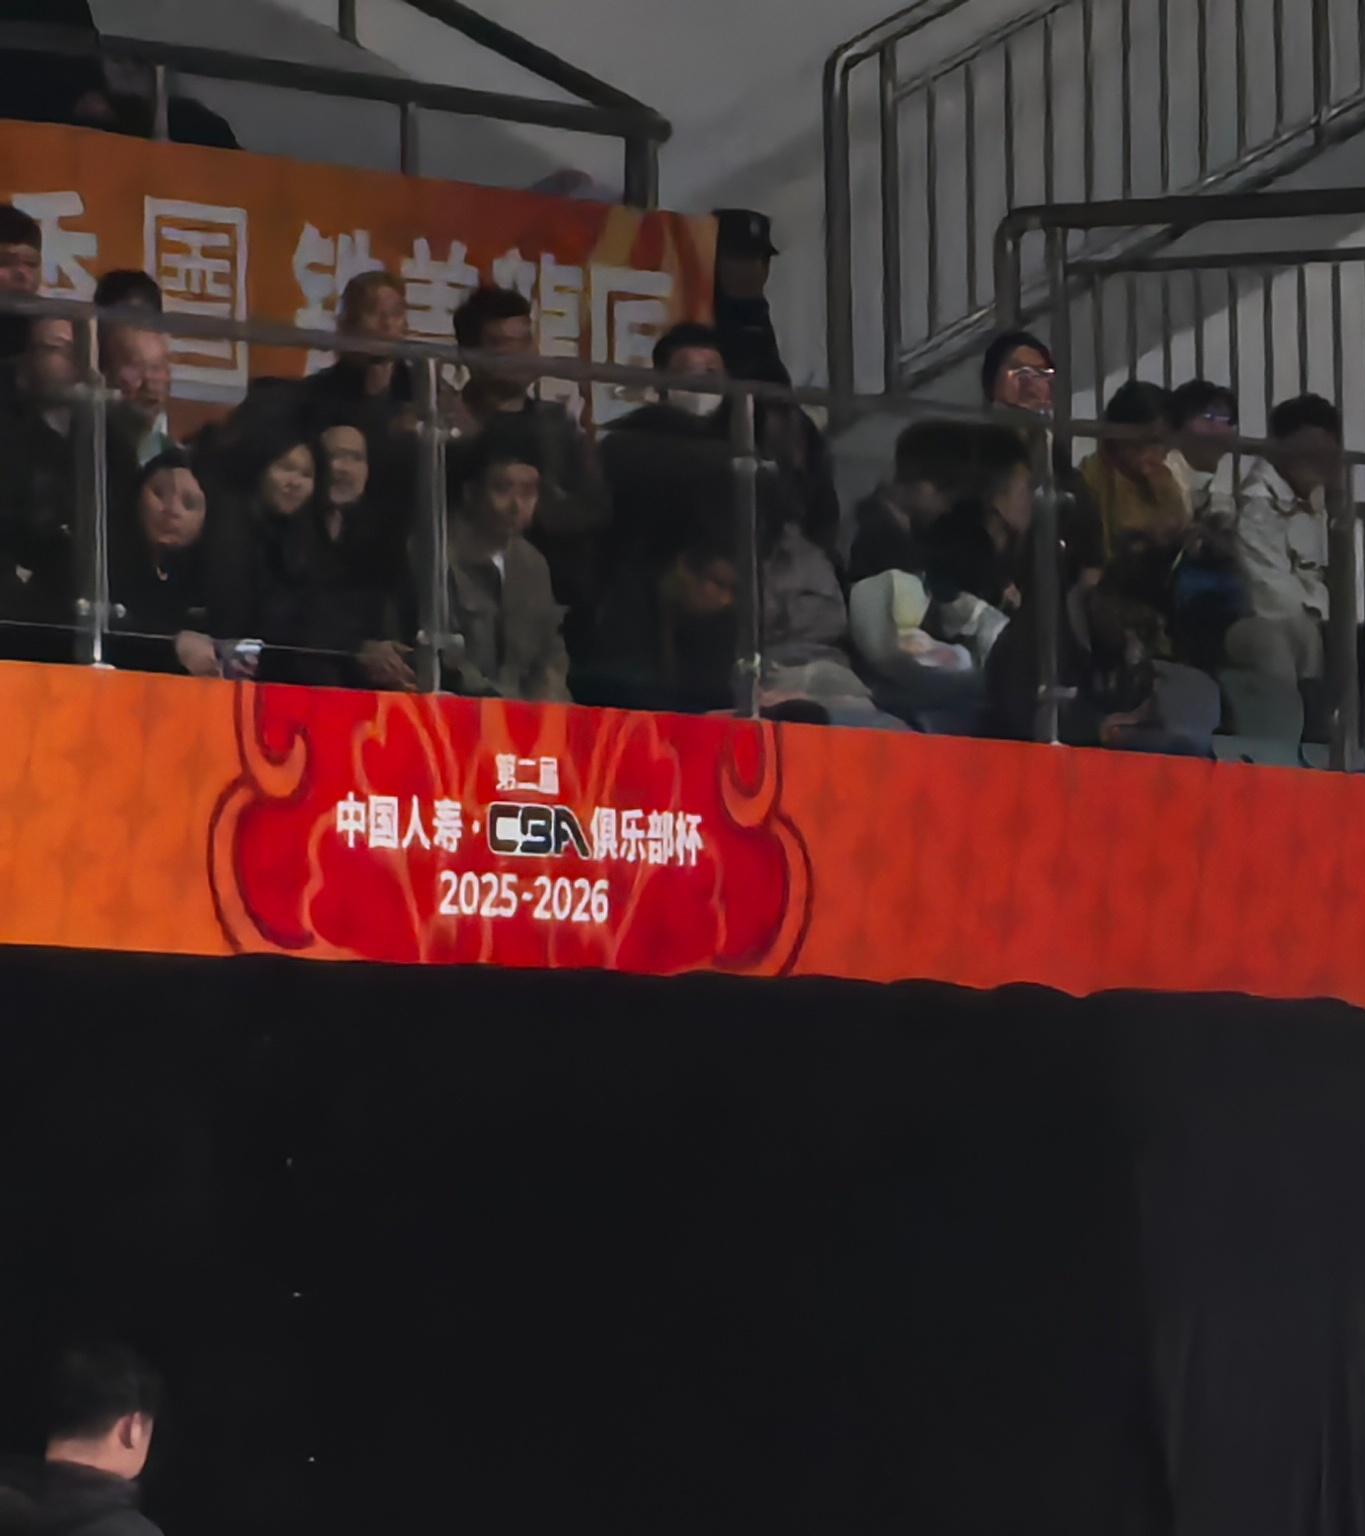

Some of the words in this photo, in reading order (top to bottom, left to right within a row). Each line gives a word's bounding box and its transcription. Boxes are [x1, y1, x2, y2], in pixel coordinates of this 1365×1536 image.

[496, 753, 559, 795] 第二届
[590, 806, 704, 867] 俱乐部杯
[439, 870, 610, 923] 2025-2026
